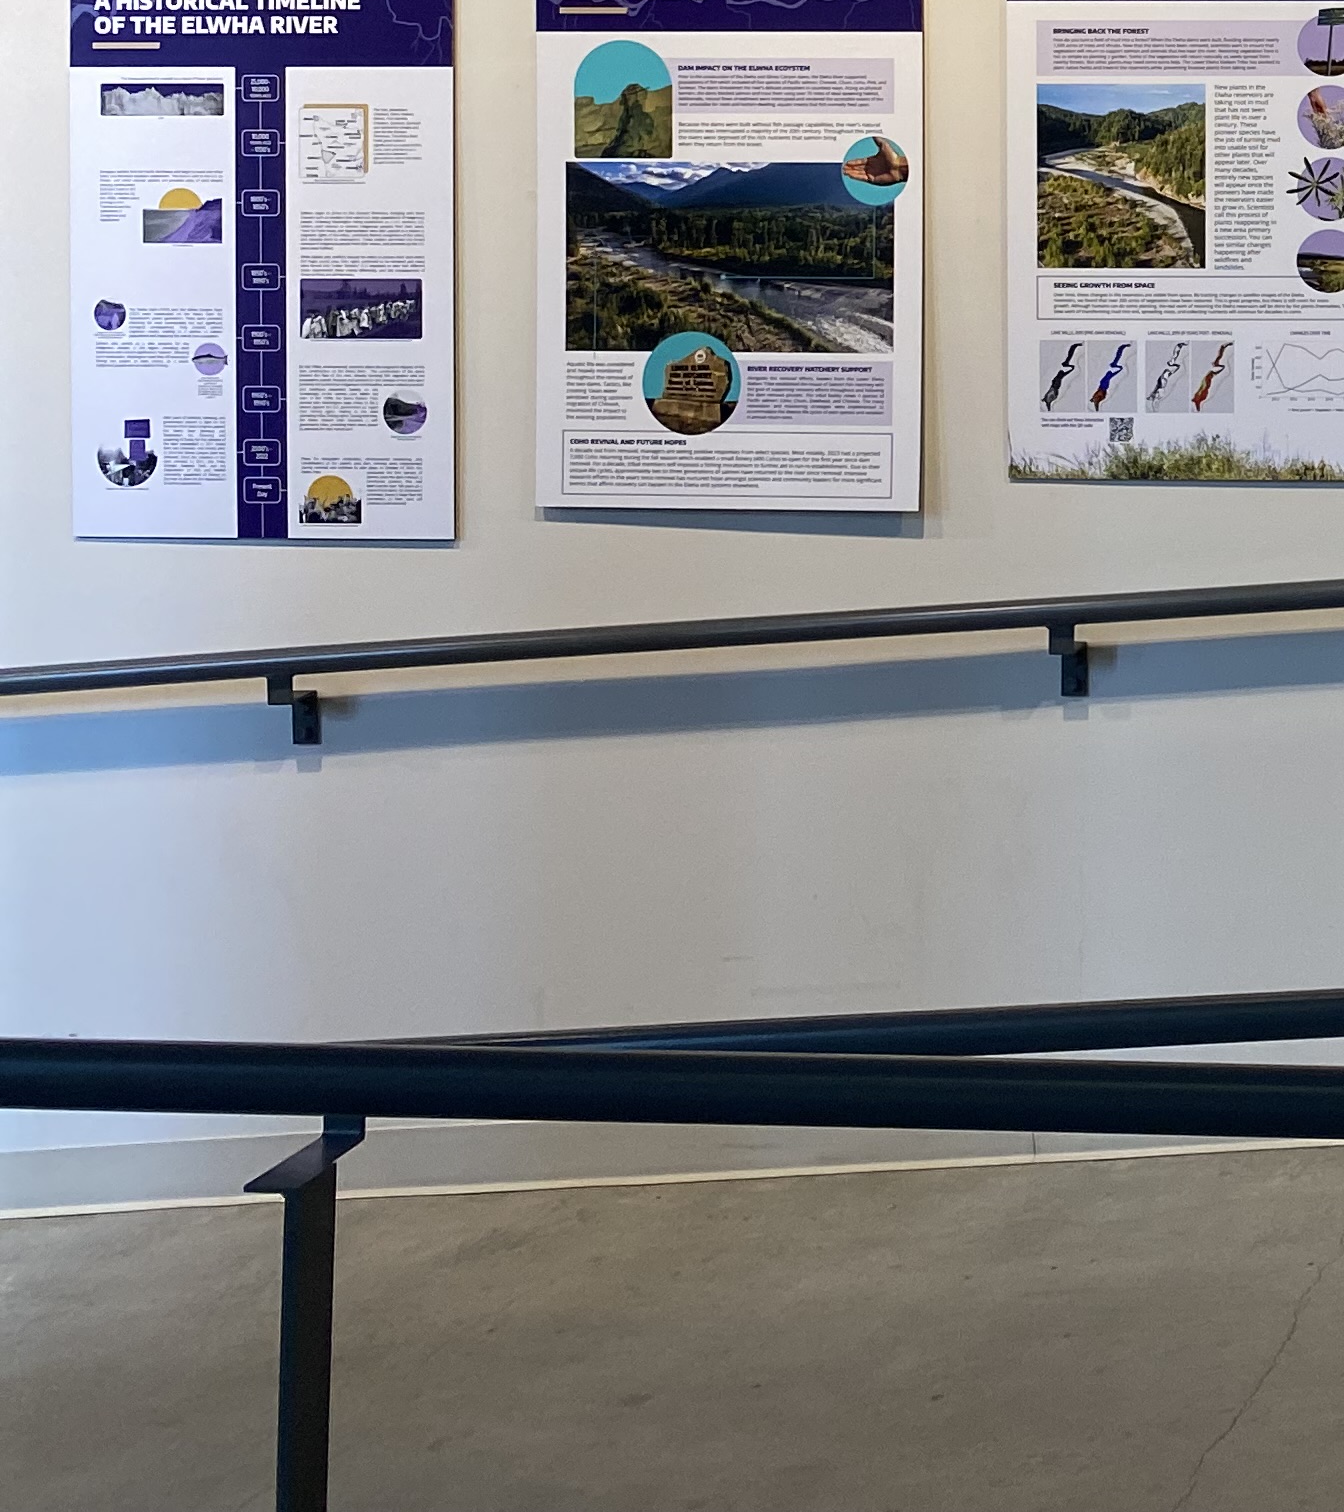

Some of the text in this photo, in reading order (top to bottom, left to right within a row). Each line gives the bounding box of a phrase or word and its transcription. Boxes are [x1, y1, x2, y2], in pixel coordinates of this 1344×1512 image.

[94, 16, 338, 34] OF THE ELWHA RIVER
[590, 438, 620, 446] REVIVAL
